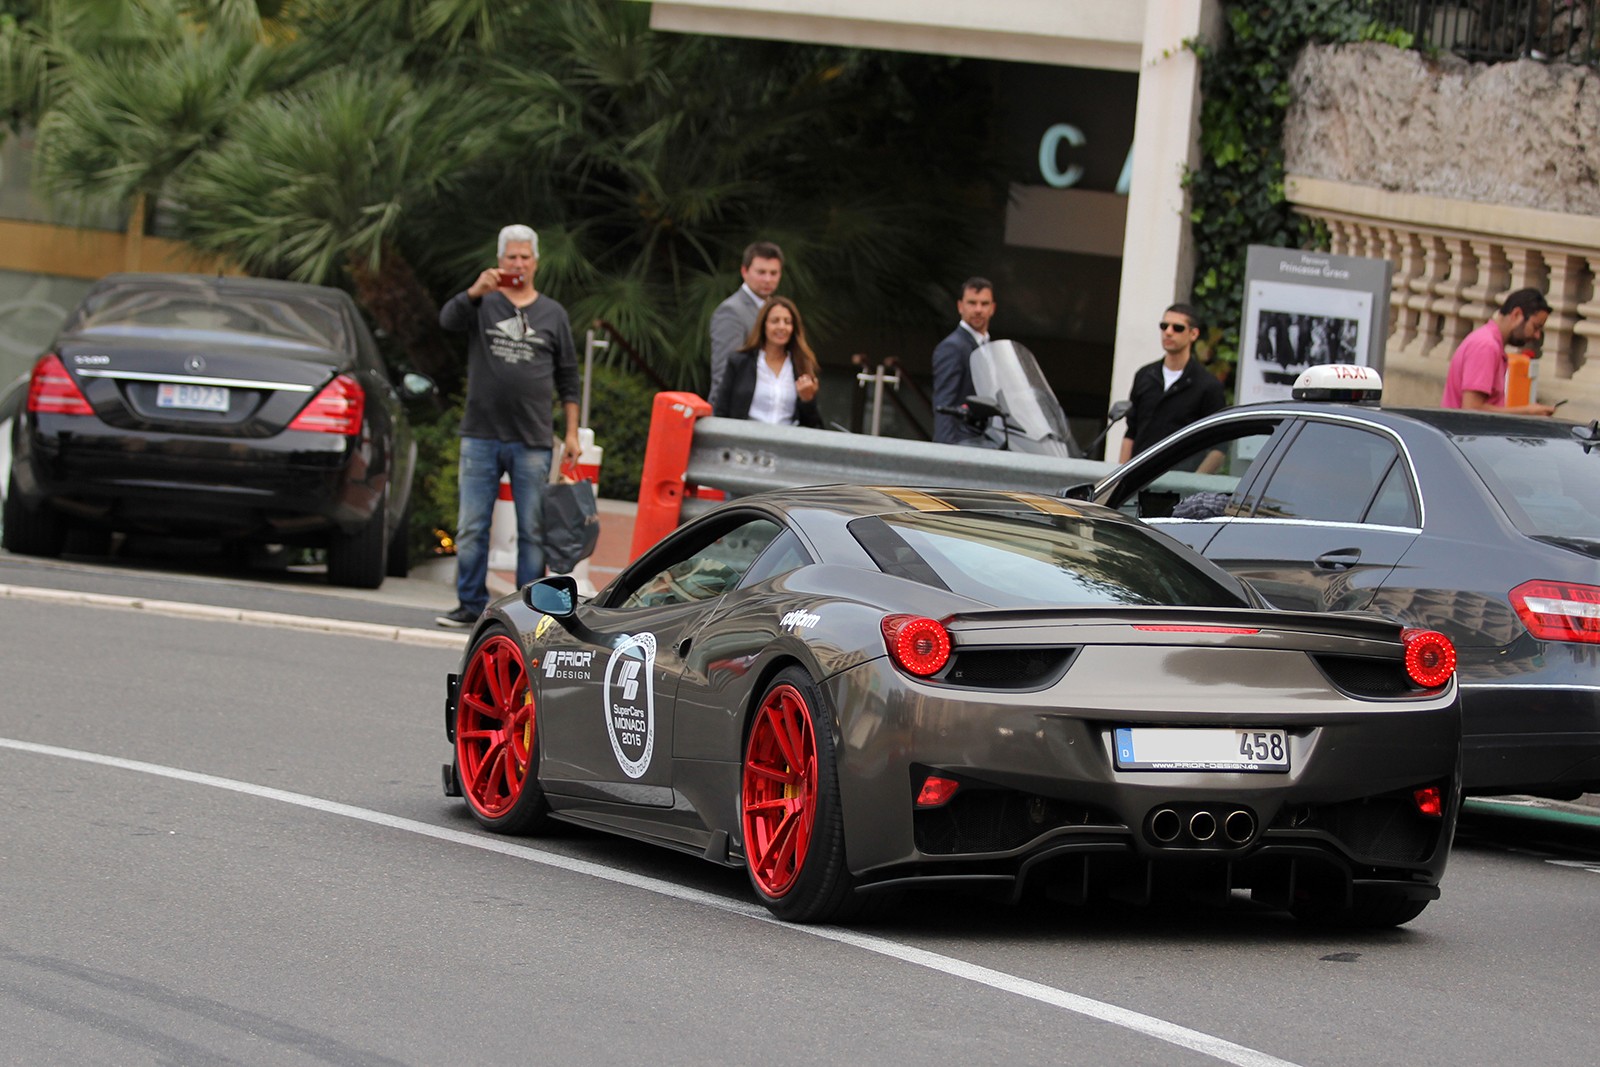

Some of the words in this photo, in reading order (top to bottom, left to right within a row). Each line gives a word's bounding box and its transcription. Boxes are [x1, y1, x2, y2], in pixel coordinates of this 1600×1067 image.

[1279, 261, 1321, 276] Princesse
[1322, 264, 1350, 280] Grace
[1330, 366, 1368, 380] TAXI
[556, 650, 592, 667] PRIOR
[556, 670, 591, 680] DESIGN
[613, 703, 645, 718] SuperCars
[614, 717, 646, 733] MONACO
[621, 732, 642, 747] 2015
[1239, 732, 1285, 761] 458
[1122, 749, 1129, 758] D
